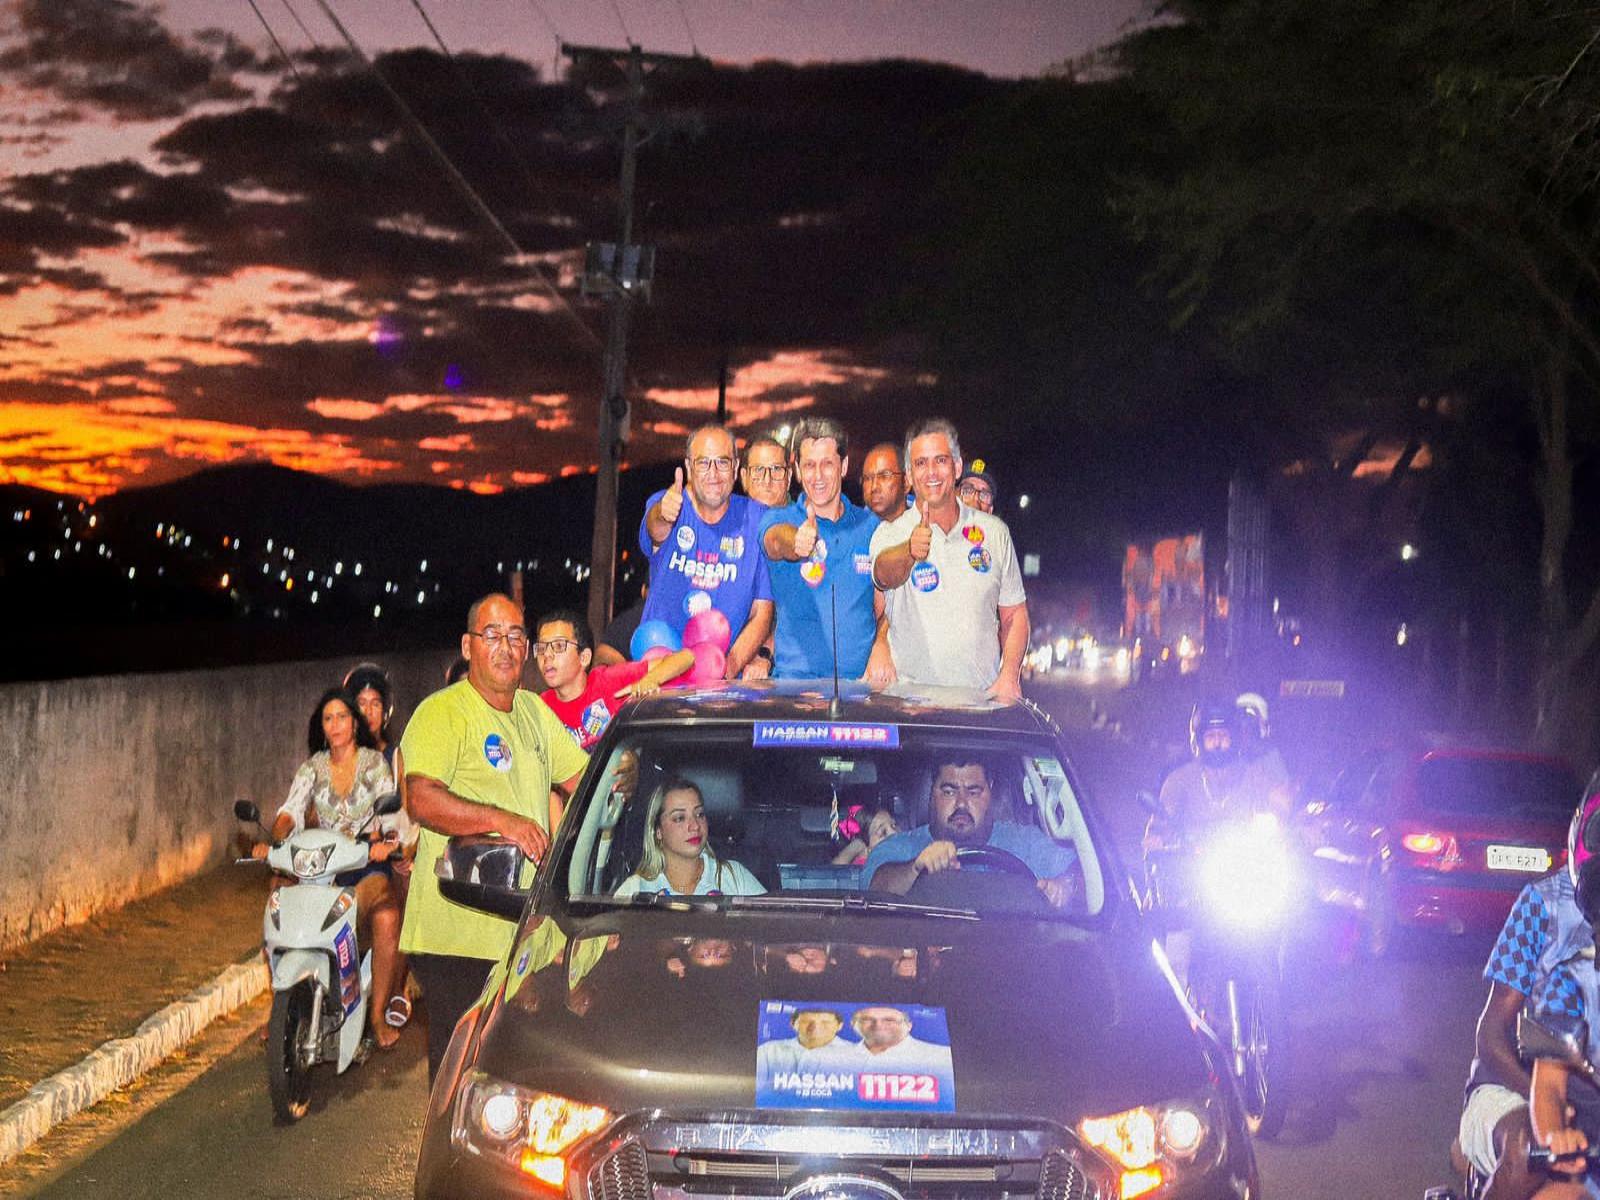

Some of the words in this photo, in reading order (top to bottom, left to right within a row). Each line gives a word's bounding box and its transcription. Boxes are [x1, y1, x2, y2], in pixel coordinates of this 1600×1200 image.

[762, 727, 828, 740] HASSAN
[774, 1072, 853, 1090] HASSAN
[861, 1075, 935, 1099] 11122
